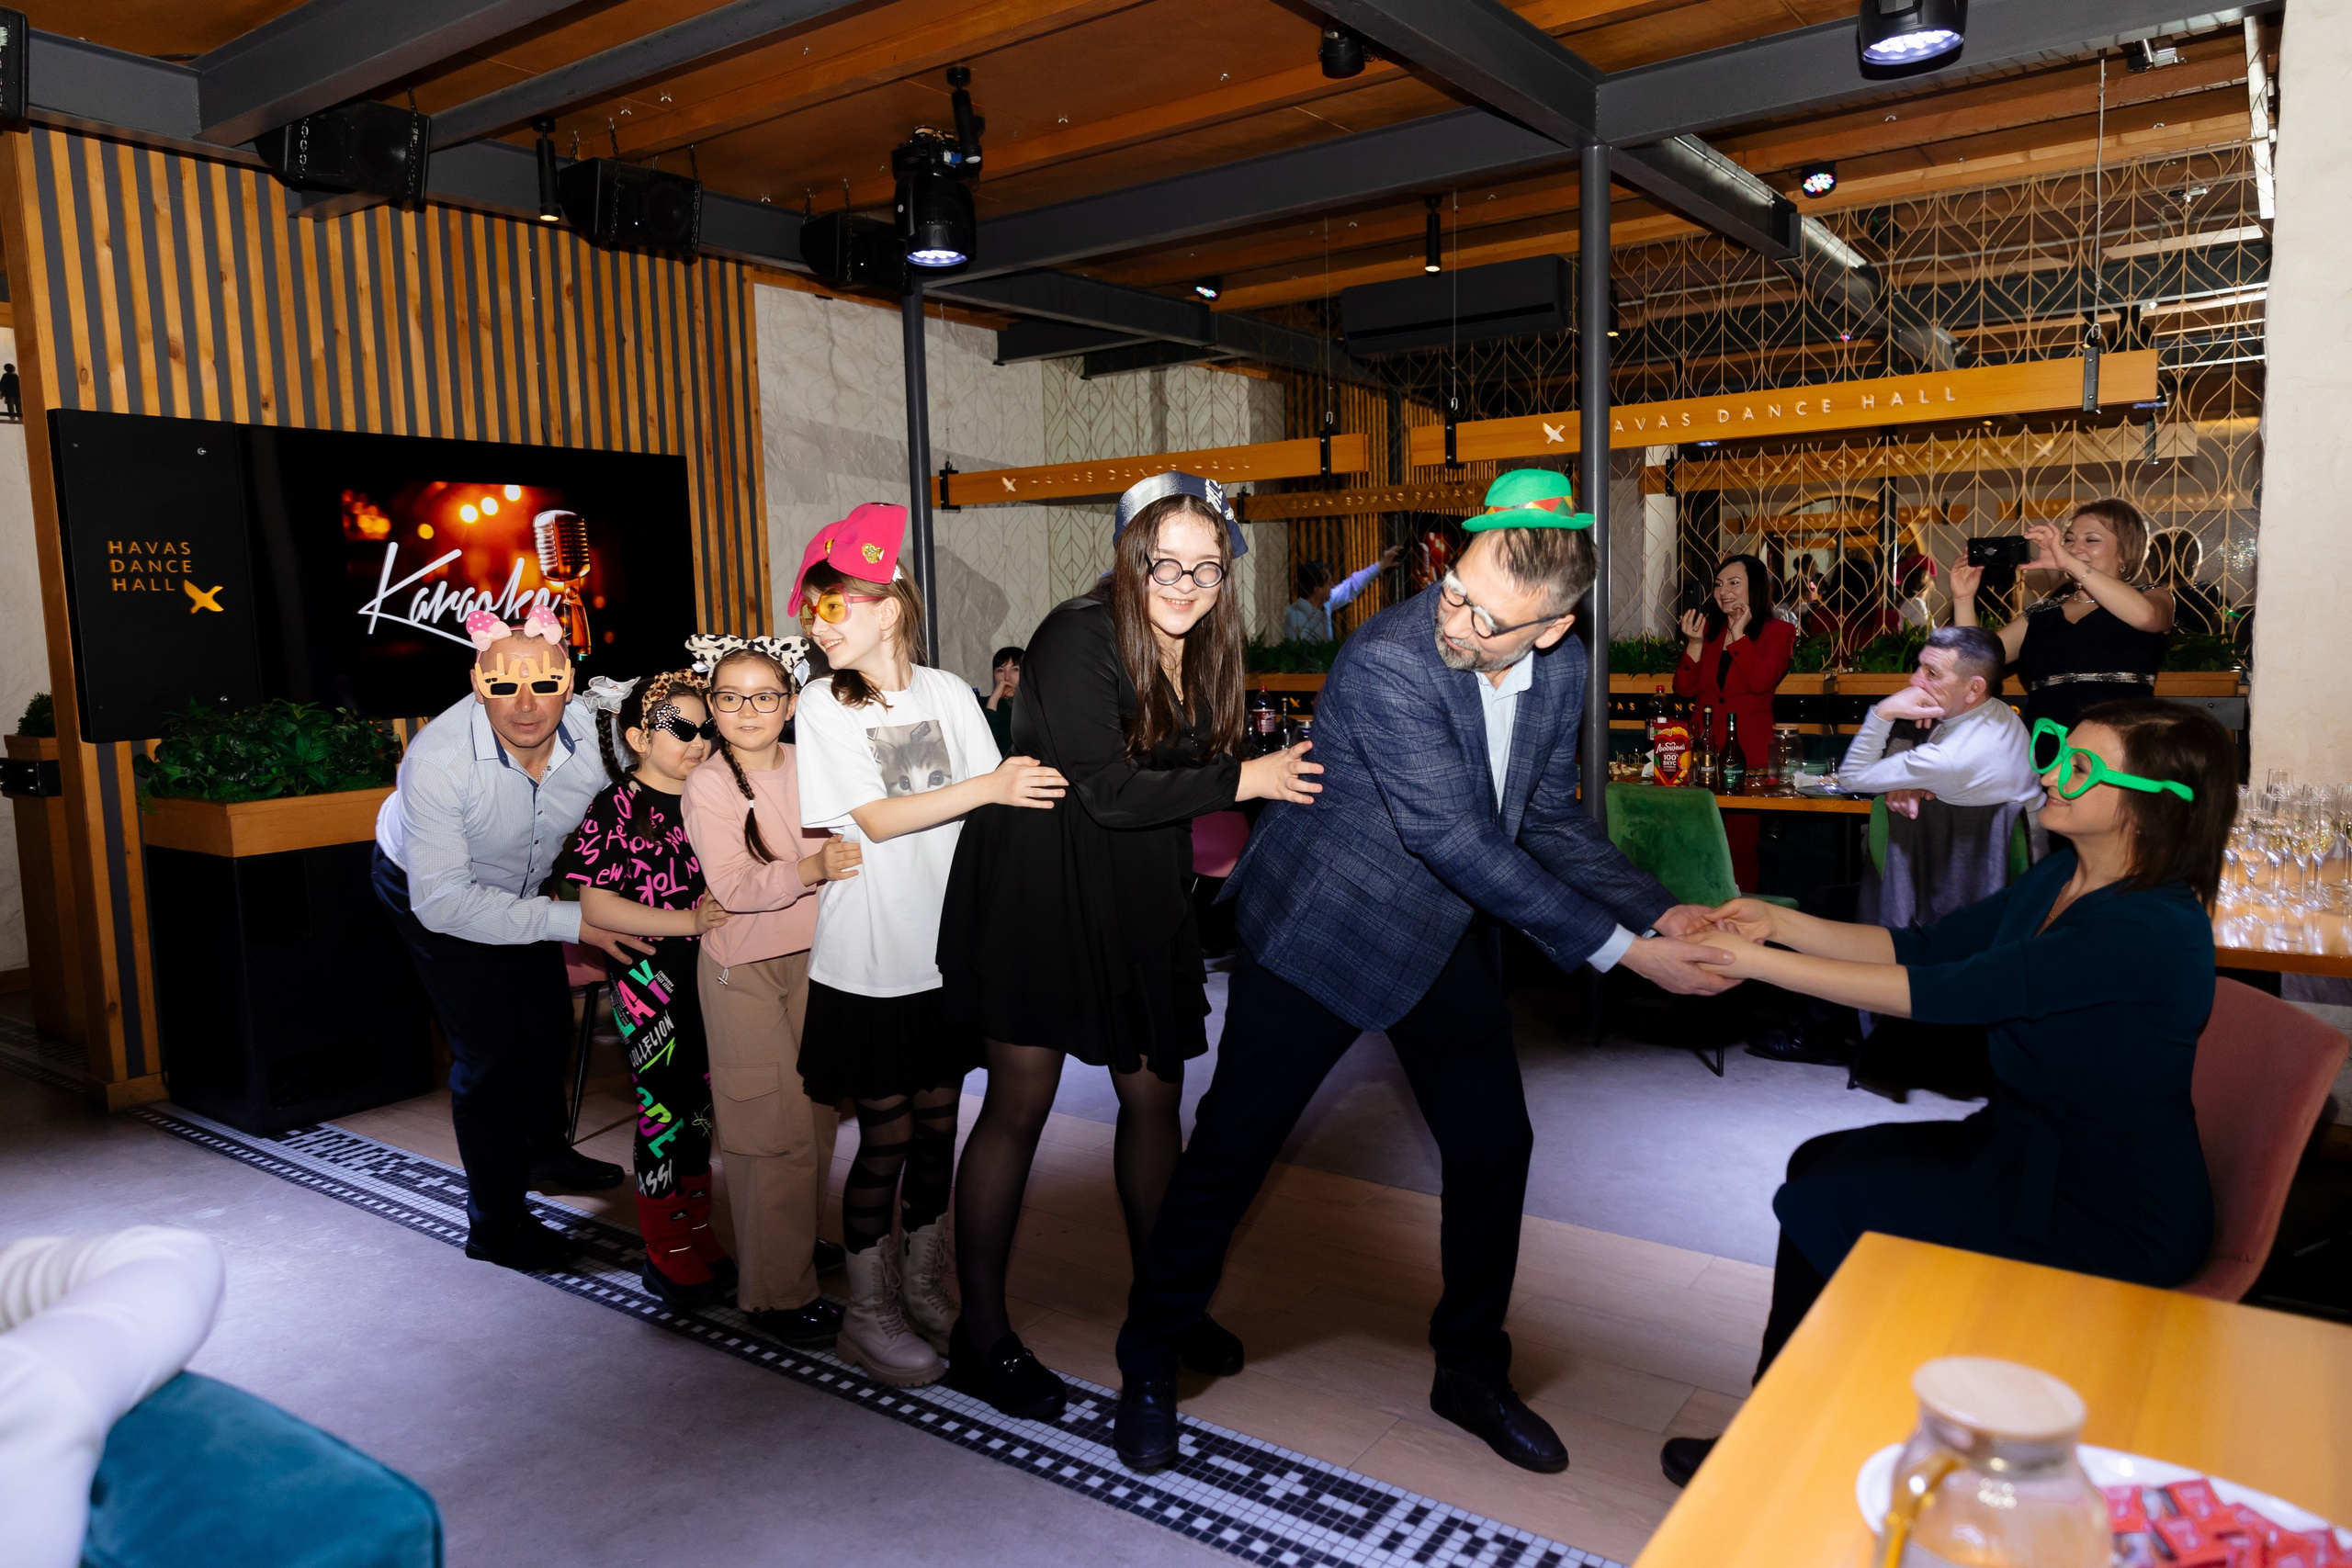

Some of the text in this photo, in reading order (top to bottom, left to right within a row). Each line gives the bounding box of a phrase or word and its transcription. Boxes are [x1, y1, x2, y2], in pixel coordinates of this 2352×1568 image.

[1613, 386, 1956, 434] AVAS DANCE HALL
[107, 540, 191, 555] HAVAS
[109, 559, 193, 573] DANCE
[111, 578, 175, 592] HALL
